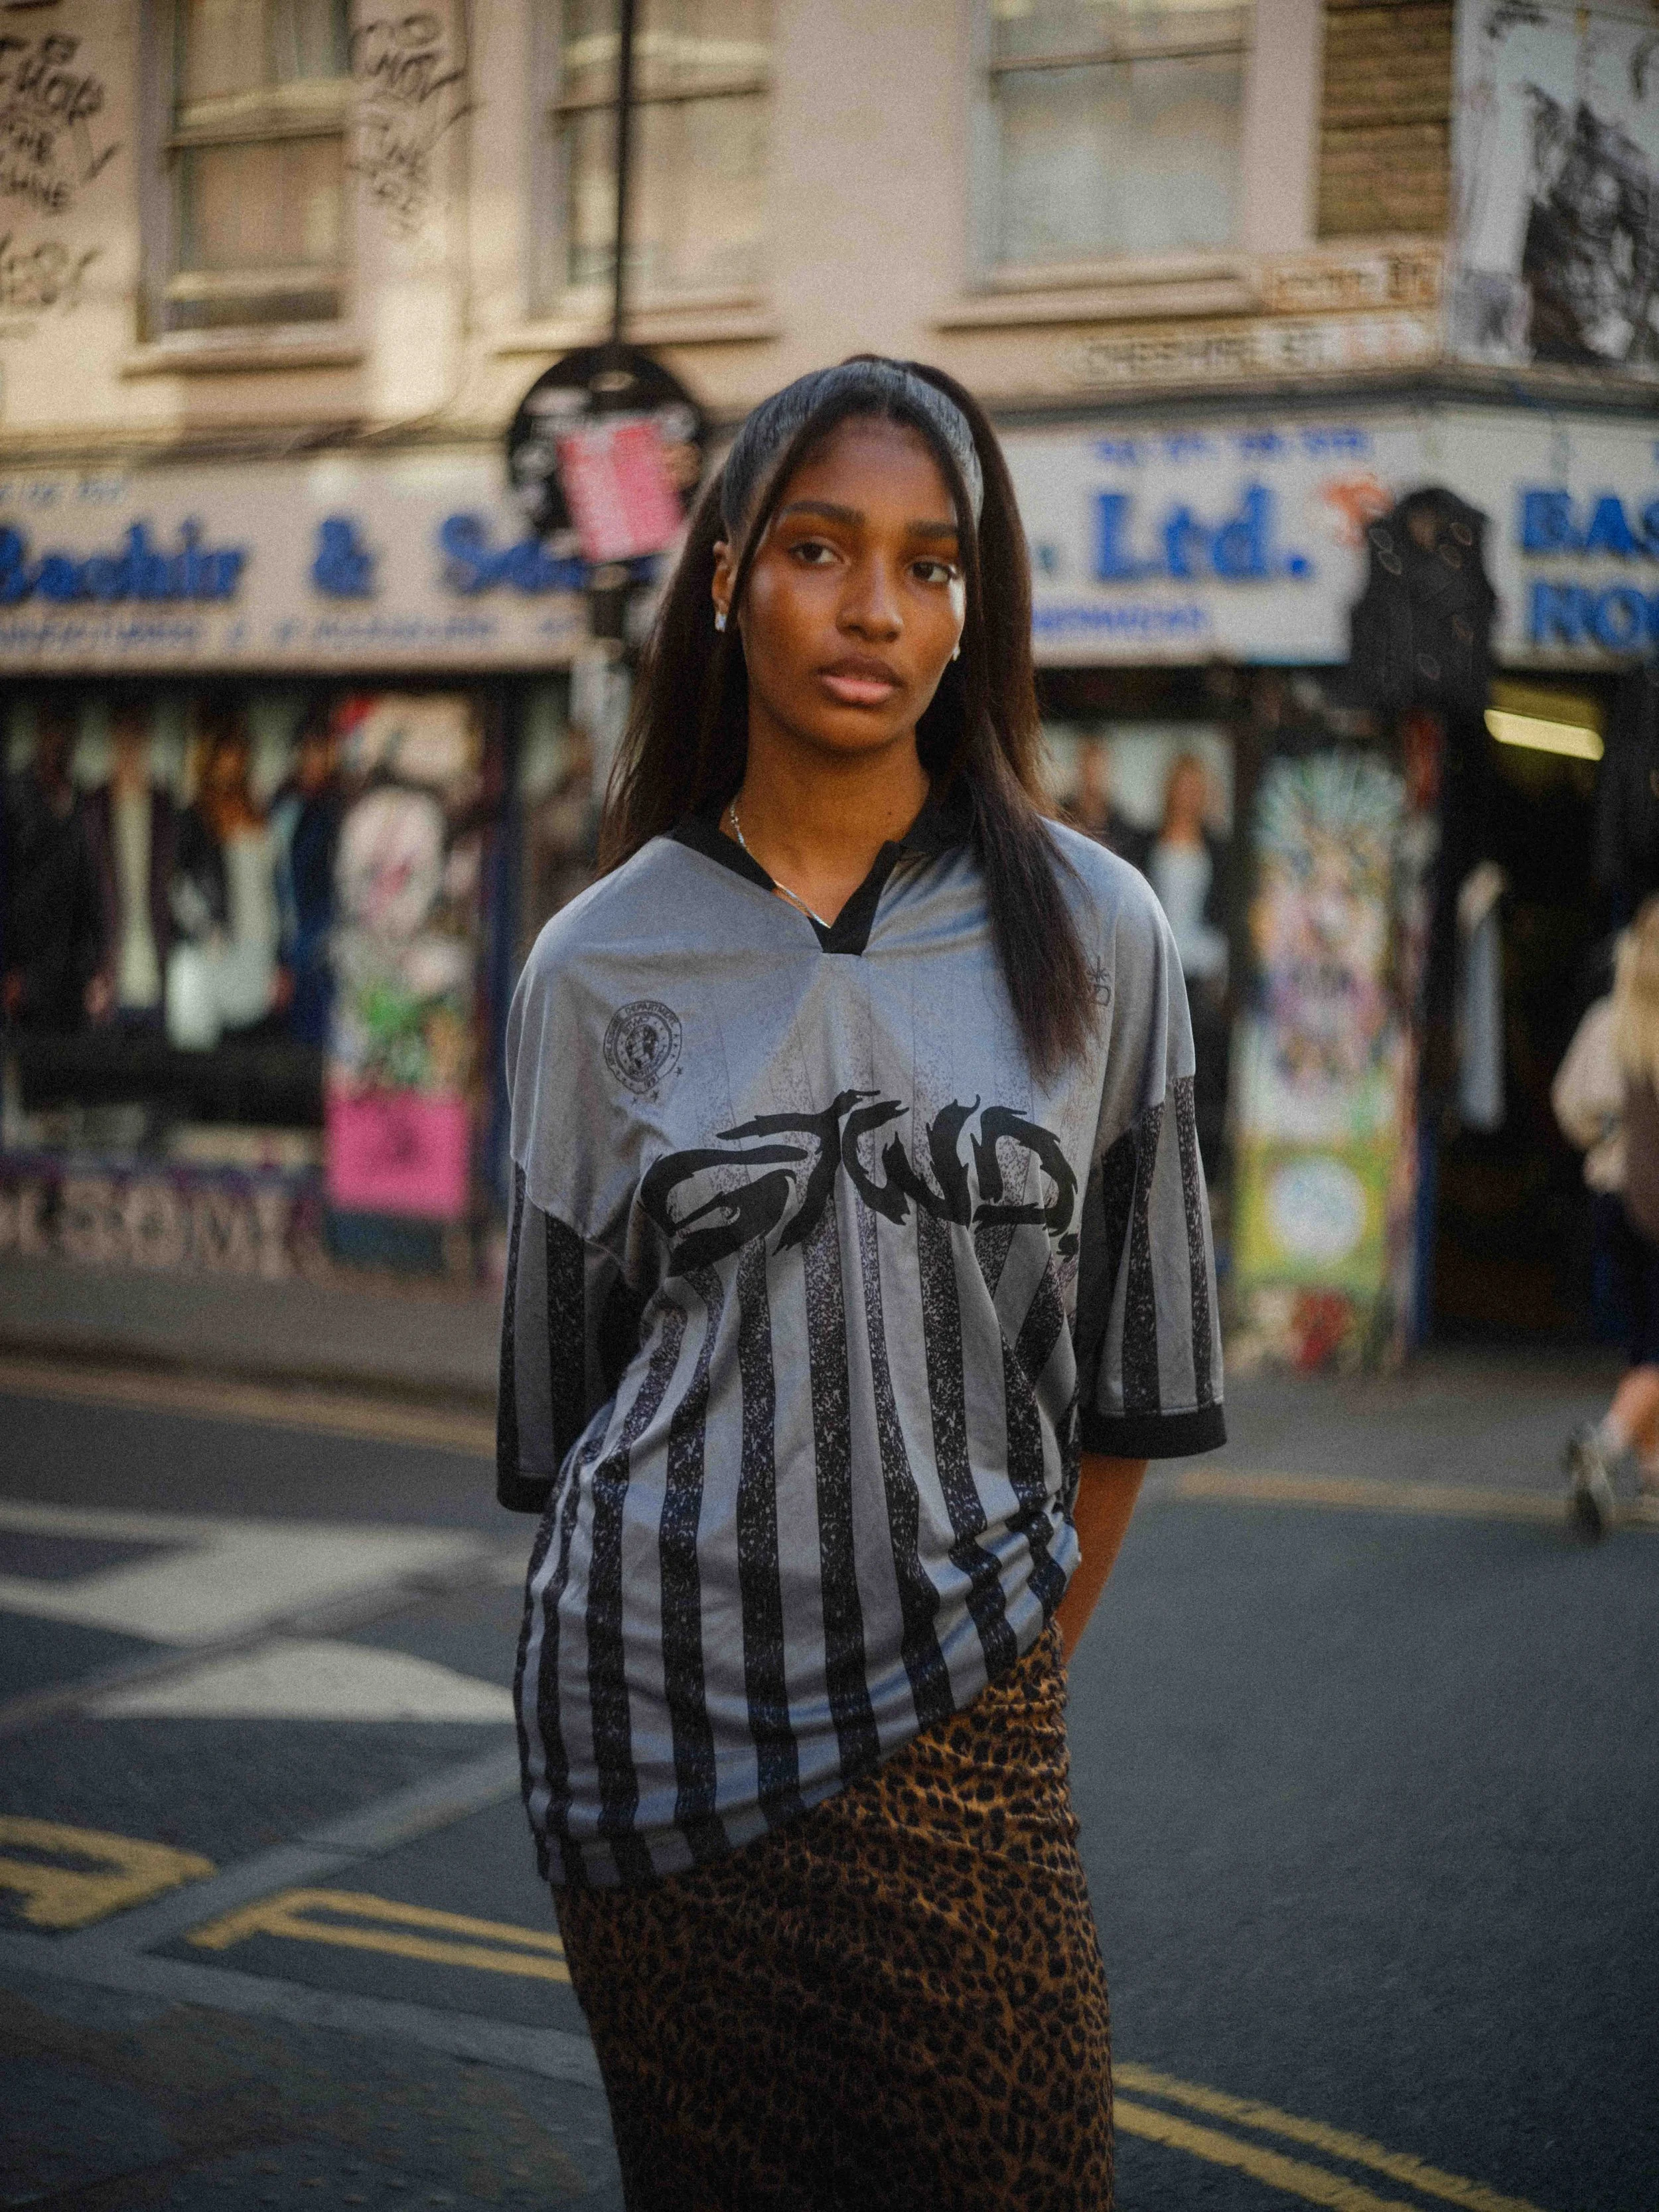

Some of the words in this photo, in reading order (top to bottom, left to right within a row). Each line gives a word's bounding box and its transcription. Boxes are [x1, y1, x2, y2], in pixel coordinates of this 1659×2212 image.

[315, 516, 373, 596] &
[1096, 479, 1310, 579] Ltd.
[1532, 581, 1659, 649] NO
